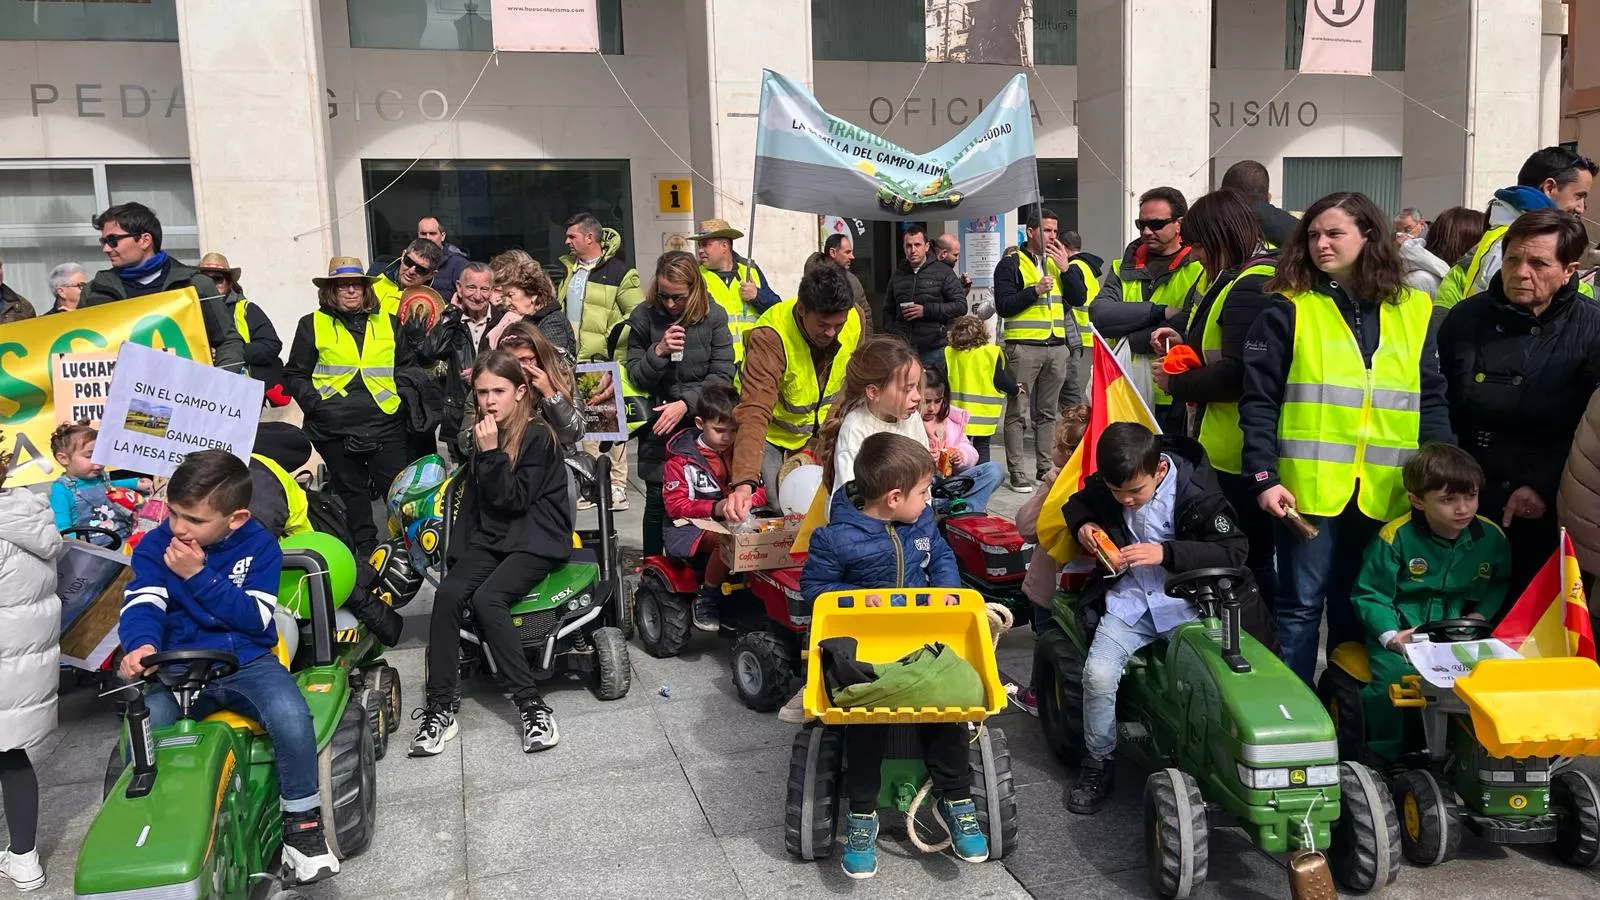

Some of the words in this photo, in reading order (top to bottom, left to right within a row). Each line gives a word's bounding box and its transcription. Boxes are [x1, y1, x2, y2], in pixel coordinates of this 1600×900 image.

[852, 145, 873, 160] DEL
[876, 151, 915, 170] CAMPO
[62, 361, 116, 378] LUCHAM
[75, 382, 102, 398] POR
[134, 382, 156, 396] SIN
[157, 388, 171, 401] EL
[174, 393, 216, 412] CAMPO
[219, 404, 228, 415] Y
[228, 407, 241, 419] LA
[73, 404, 105, 421] FUTU
[166, 429, 234, 454] GANADERIA
[113, 440, 129, 453] LA
[132, 444, 166, 461] MESA
[168, 452, 185, 464] ES
[550, 586, 574, 603] RSX
